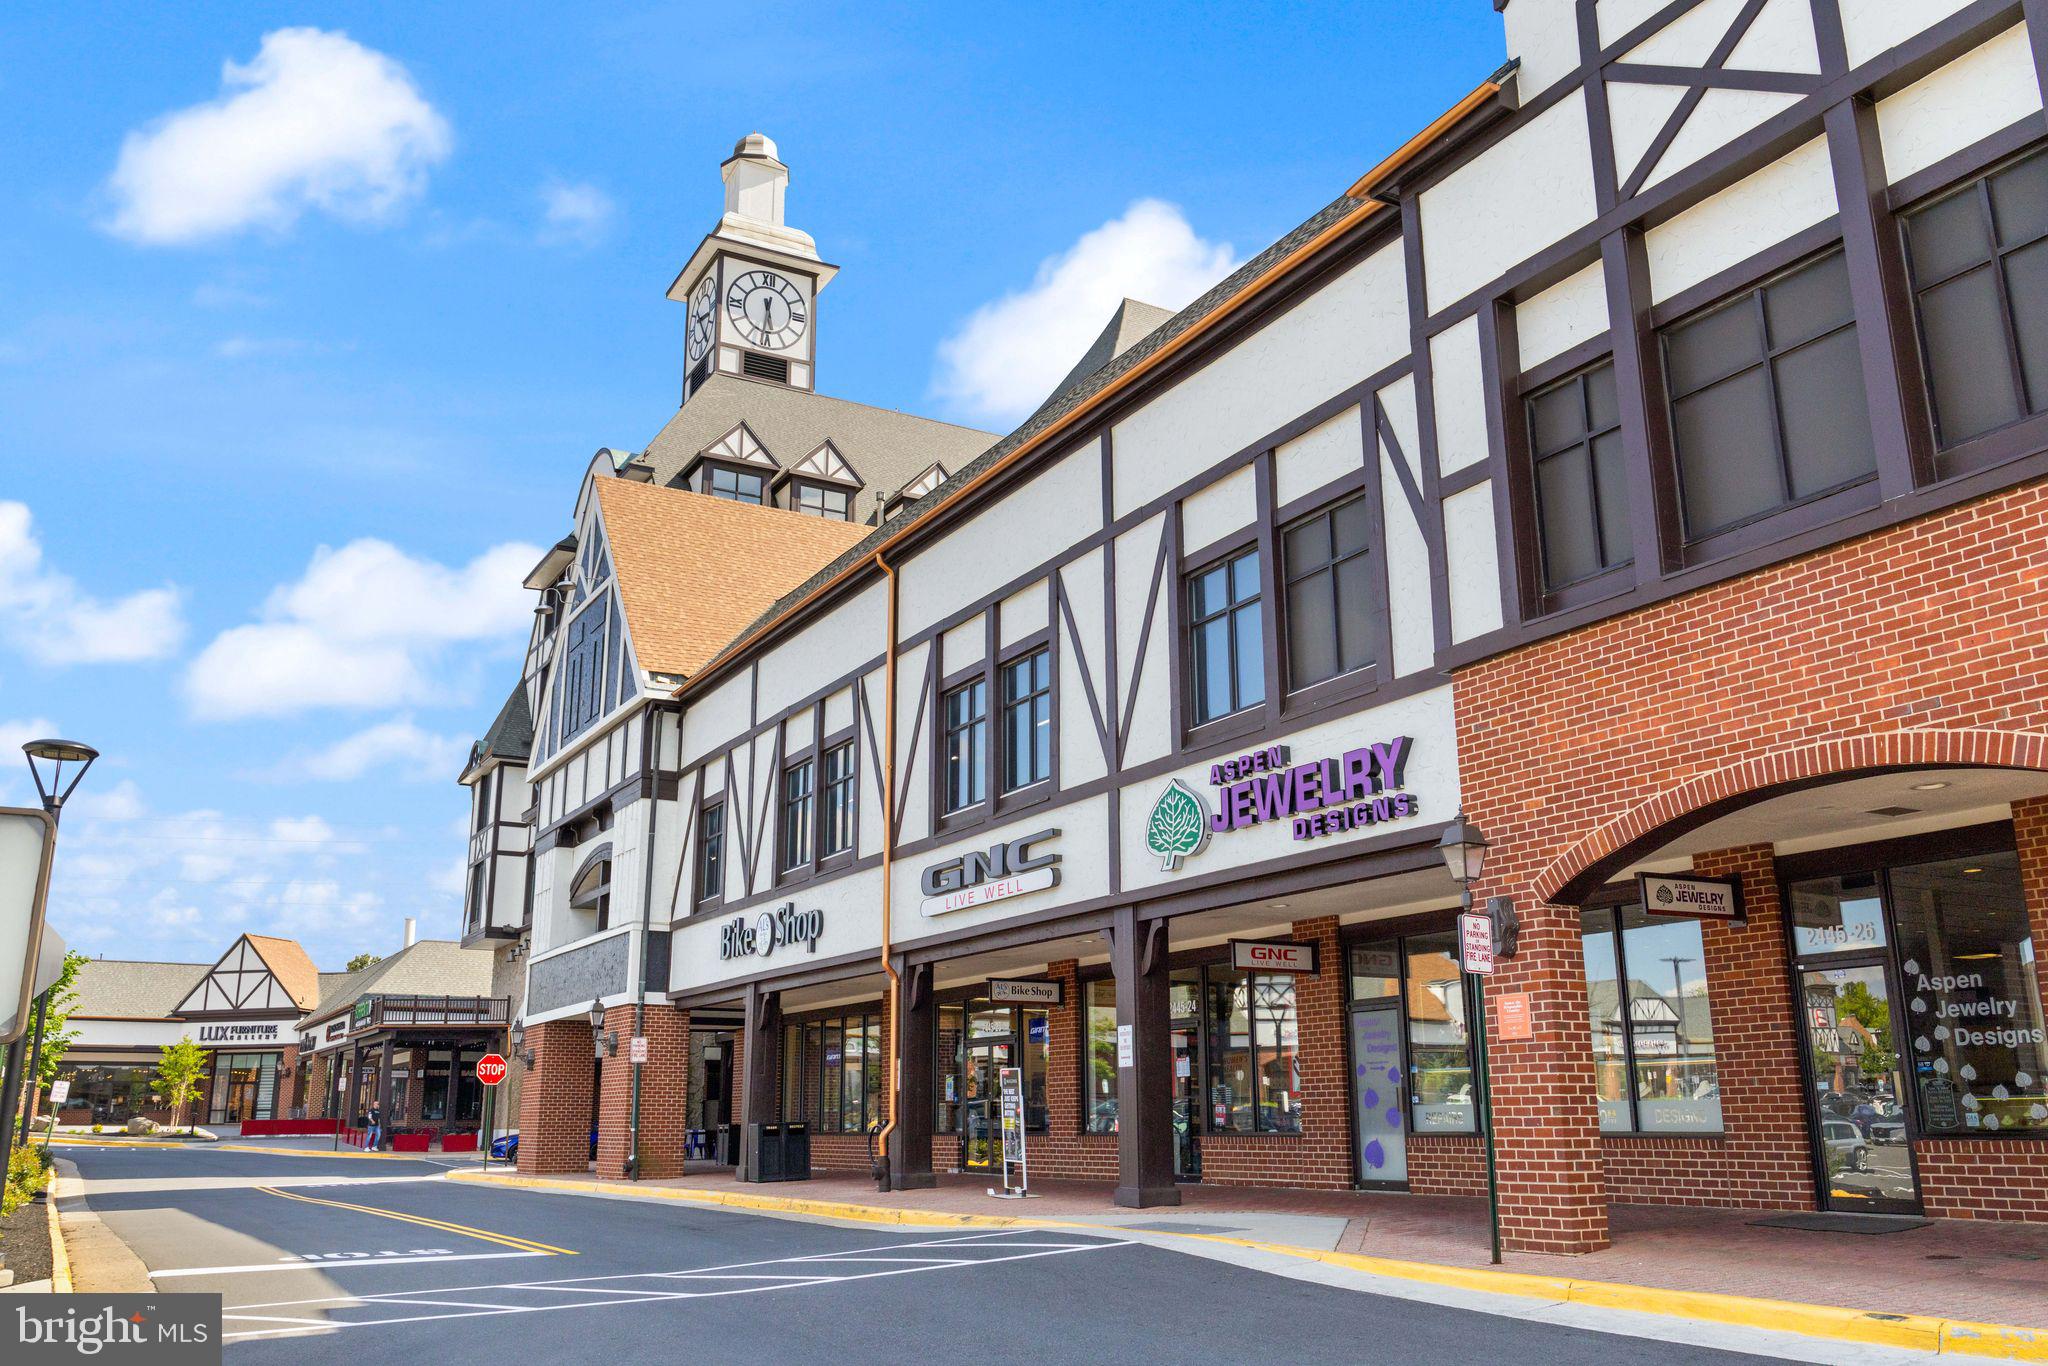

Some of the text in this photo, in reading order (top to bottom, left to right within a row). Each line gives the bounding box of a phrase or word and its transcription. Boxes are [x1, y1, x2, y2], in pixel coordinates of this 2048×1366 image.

[762, 273, 776, 288] XII
[1210, 744, 1291, 786] ASPEN
[1210, 736, 1414, 833] JEWELRY
[1292, 792, 1419, 841] DESIGNS
[921, 828, 1062, 897] GNC
[945, 879, 1024, 911] LIVE WELL
[1675, 891, 1724, 905] JEWELRY
[1698, 904, 1726, 912] DESIGNS
[720, 917, 757, 960] Bike
[776, 902, 824, 954] Shop
[1472, 922, 1481, 930] NO
[1807, 921, 1877, 946] 2445-26
[1466, 930, 1489, 939] PARKING
[1250, 947, 1297, 961] GNC
[1466, 942, 1490, 953] STANDING
[1251, 959, 1270, 967] LIVE
[1466, 951, 1491, 963] FIRE LANE
[1917, 973, 1983, 993] Aspen
[1011, 985, 1030, 996] Bike
[1031, 986, 1053, 999] Shop
[1935, 997, 2017, 1019] Jewelry
[199, 1025, 229, 1041] LUX
[230, 1024, 278, 1035] FURNITURE
[1953, 1026, 2045, 1049] Designs
[478, 1063, 506, 1077] STOP
